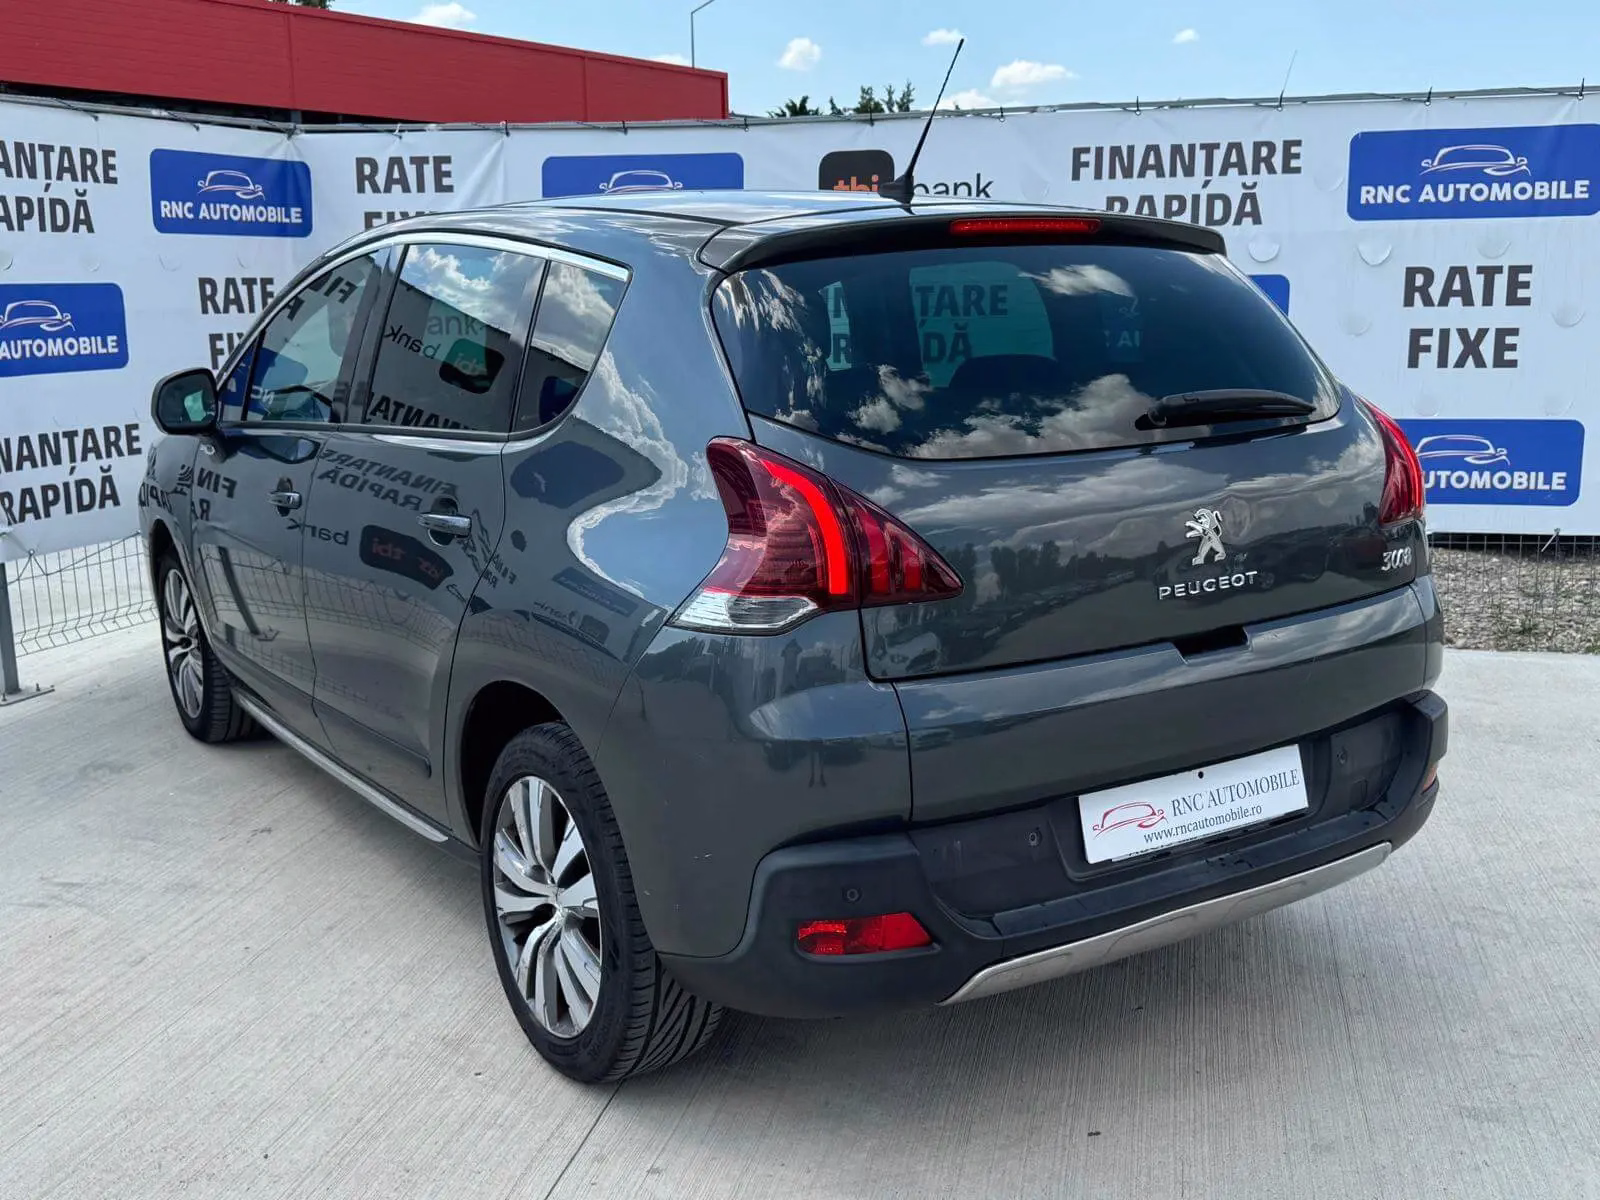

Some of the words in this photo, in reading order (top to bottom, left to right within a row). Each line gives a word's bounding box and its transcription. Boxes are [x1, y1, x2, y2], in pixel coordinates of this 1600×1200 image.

[355, 155, 454, 194] RATE
[1360, 184, 1411, 205] RNC
[1418, 179, 1590, 204] AUTOMOBILE
[160, 200, 194, 219] RNC
[198, 202, 303, 223] AUTOMOBILE
[1403, 264, 1533, 308] RATE
[1407, 327, 1521, 369] FIXE
[0, 464, 120, 526] RAPIDĂ
[1381, 546, 1412, 571] 3008
[1158, 571, 1258, 600] PEUGEOT
[1171, 793, 1205, 817] RNC
[1207, 769, 1300, 808] AUTOMOBILE
[1144, 804, 1263, 843] www.rncautomobile.ro
